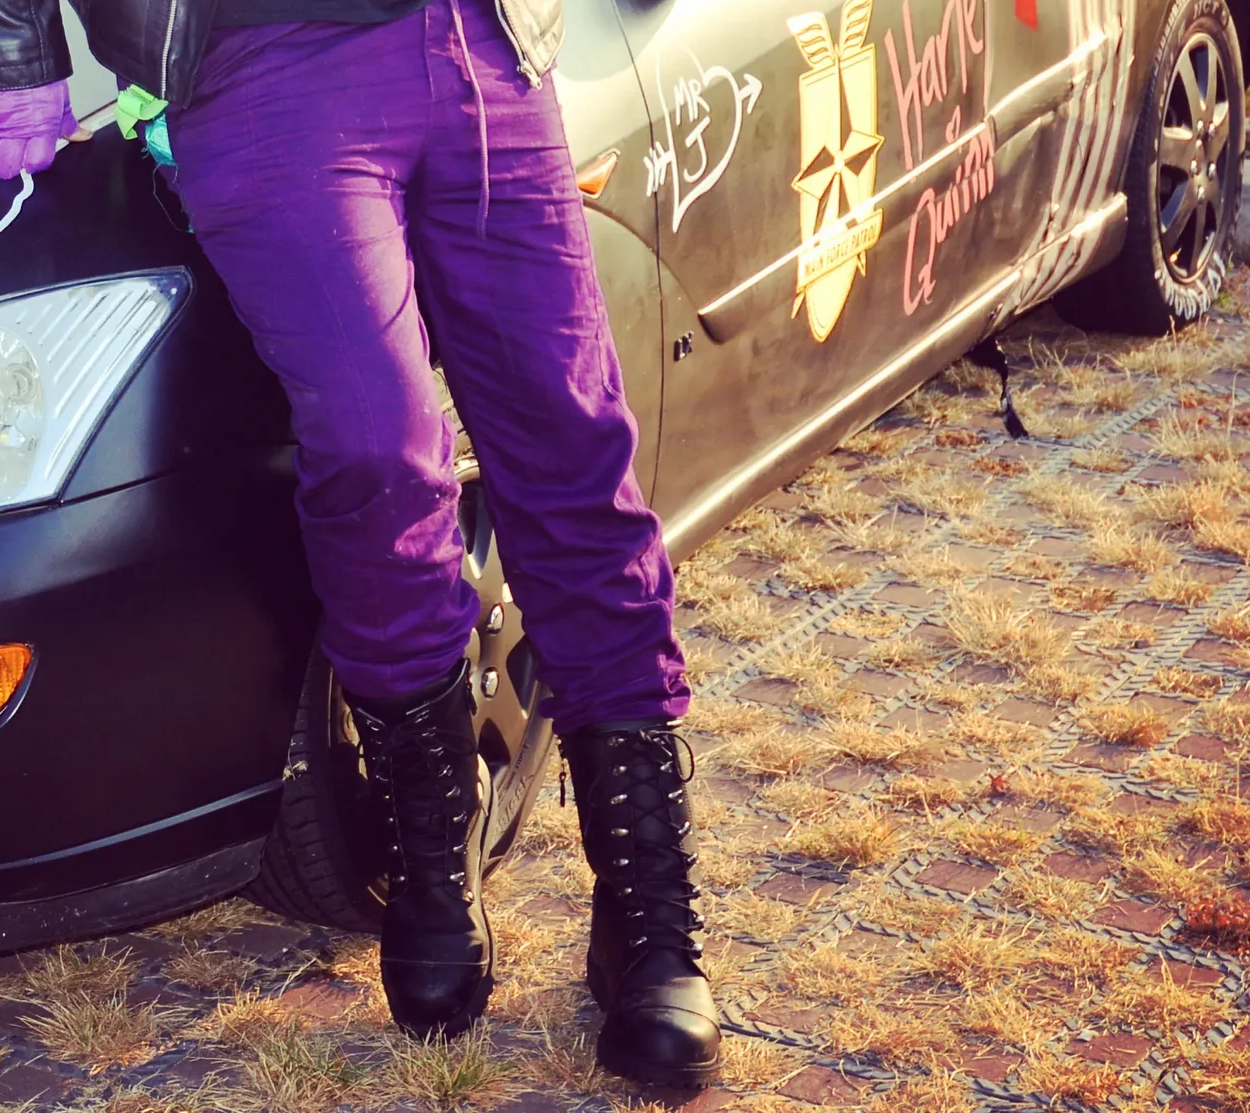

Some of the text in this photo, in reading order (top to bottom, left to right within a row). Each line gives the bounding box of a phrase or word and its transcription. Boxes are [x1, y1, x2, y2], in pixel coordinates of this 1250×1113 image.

[673, 75, 711, 127] MR
[683, 114, 712, 183] J
[851, 224, 877, 249] PATROL
[903, 121, 995, 317] Quinn
